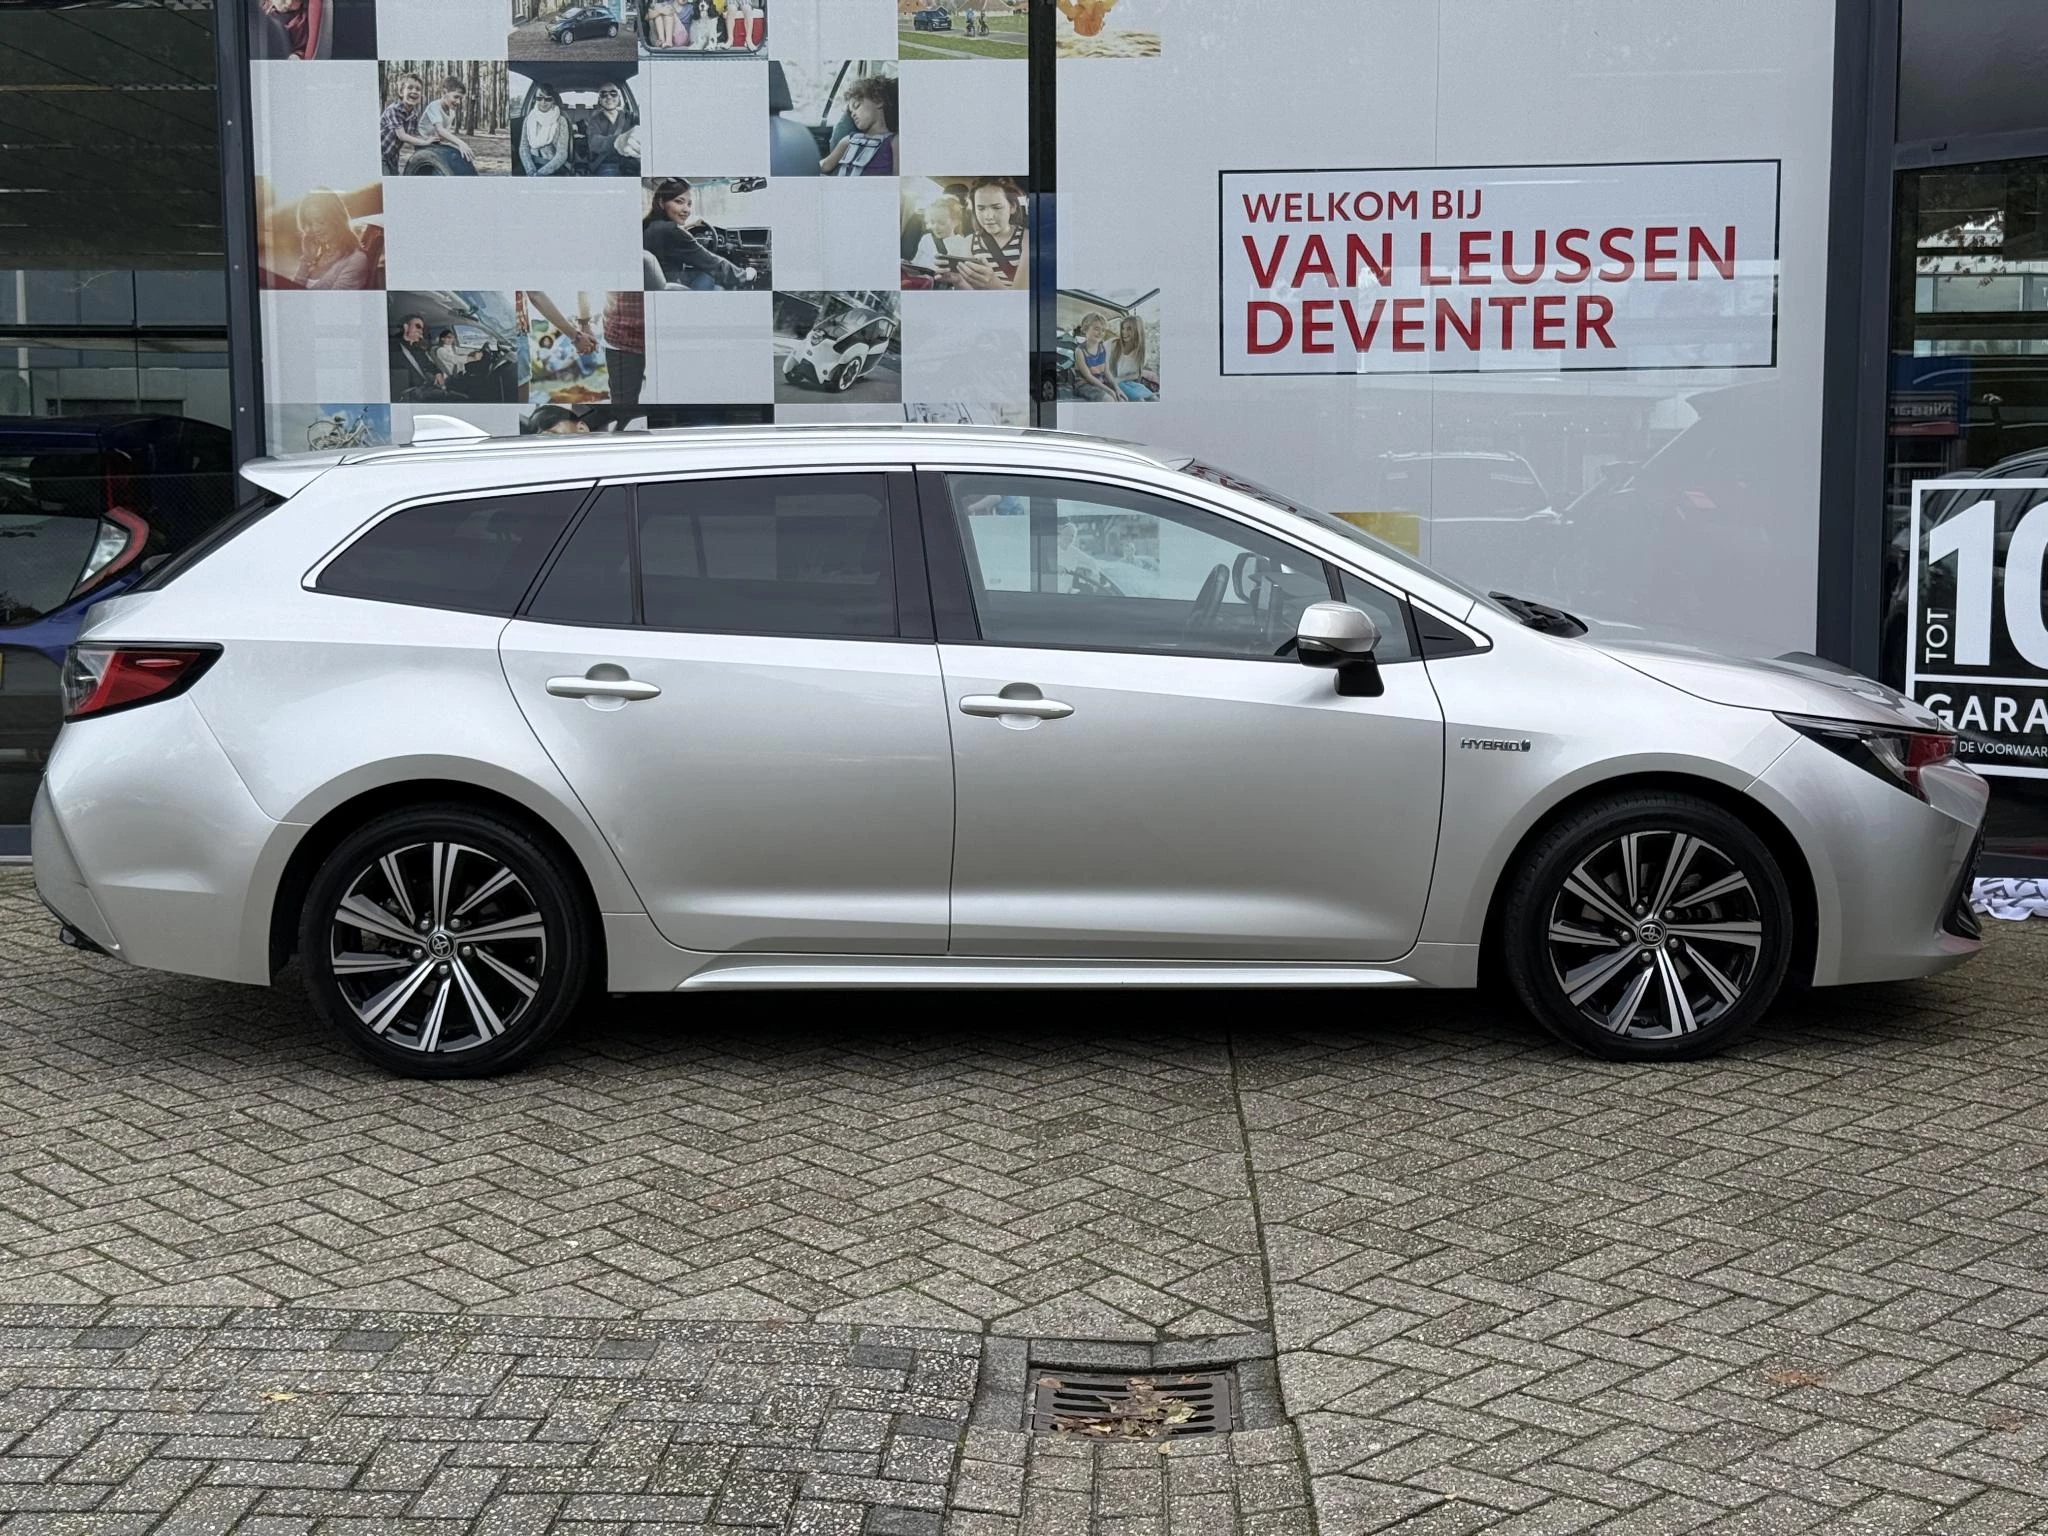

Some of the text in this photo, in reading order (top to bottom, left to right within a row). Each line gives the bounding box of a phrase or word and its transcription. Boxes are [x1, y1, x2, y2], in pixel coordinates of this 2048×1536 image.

[1243, 190, 1483, 223] WELKOM BIJ
[1242, 226, 1736, 289] VAN LEUSSEN
[1246, 296, 1616, 355] DEVENTER
[1926, 607, 1949, 664] TOT
[1460, 738, 1520, 752] HYBRID
[1959, 741, 2048, 758] DE VOORWAAR
